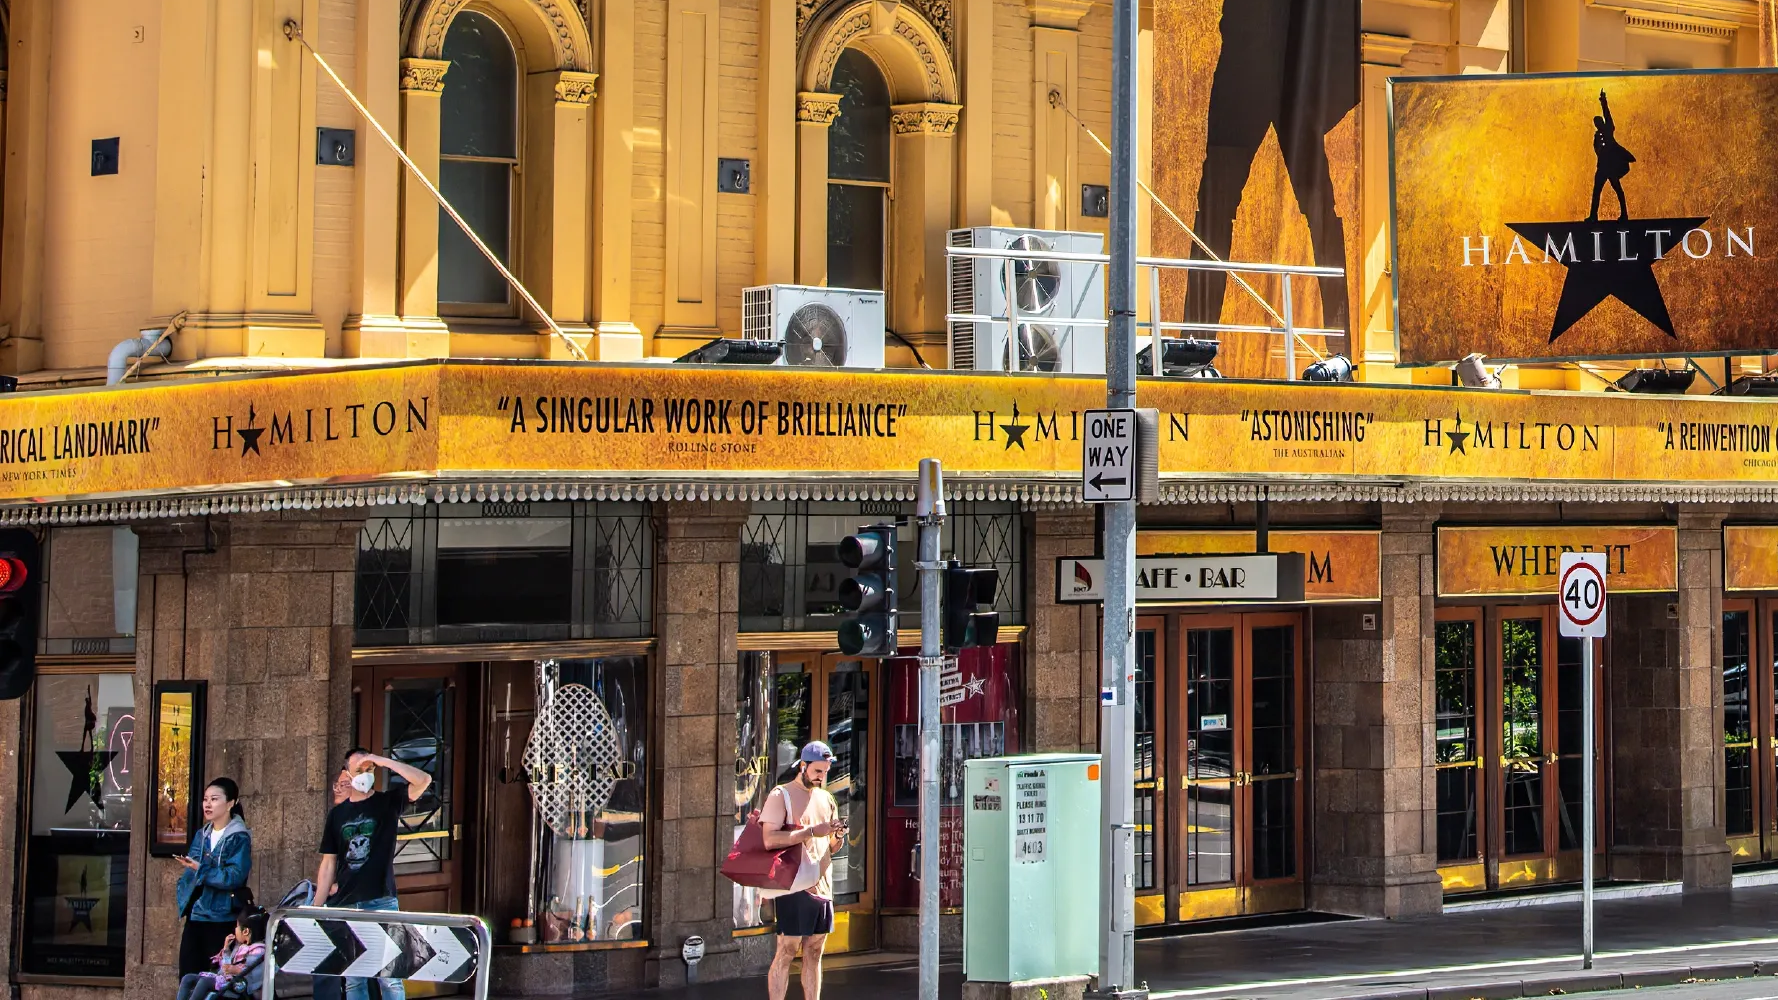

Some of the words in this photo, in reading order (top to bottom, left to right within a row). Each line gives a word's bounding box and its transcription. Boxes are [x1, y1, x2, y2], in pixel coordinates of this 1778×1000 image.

[1461, 226, 1755, 267] HAMILTON
[497, 396, 527, 432] "A
[536, 396, 655, 433] SINGULAR
[664, 398, 730, 434] WORK
[741, 400, 768, 435] OF
[777, 401, 907, 437] BRILLIANCE"
[1092, 418, 1126, 438] ONE
[1241, 409, 1374, 442] "ASTONISHING"
[54, 417, 159, 459] LANDMARK"
[668, 441, 717, 453] ROLLING
[720, 442, 757, 454] STONE
[1680, 422, 1770, 453] REINVENTION
[1089, 446, 1128, 467] WAY
[1273, 448, 1289, 458] THE
[1291, 448, 1345, 459] AUSTRALIAN
[23, 471, 47, 481] YORK
[51, 468, 76, 479] TIMES
[1489, 545, 1593, 576] WHE
[1604, 544, 1631, 575] IT
[1135, 568, 1178, 589] AFE
[1199, 568, 1246, 589] BAR
[1565, 579, 1599, 610] 40
[1019, 814, 1025, 823] 13
[1028, 813, 1034, 823] 11
